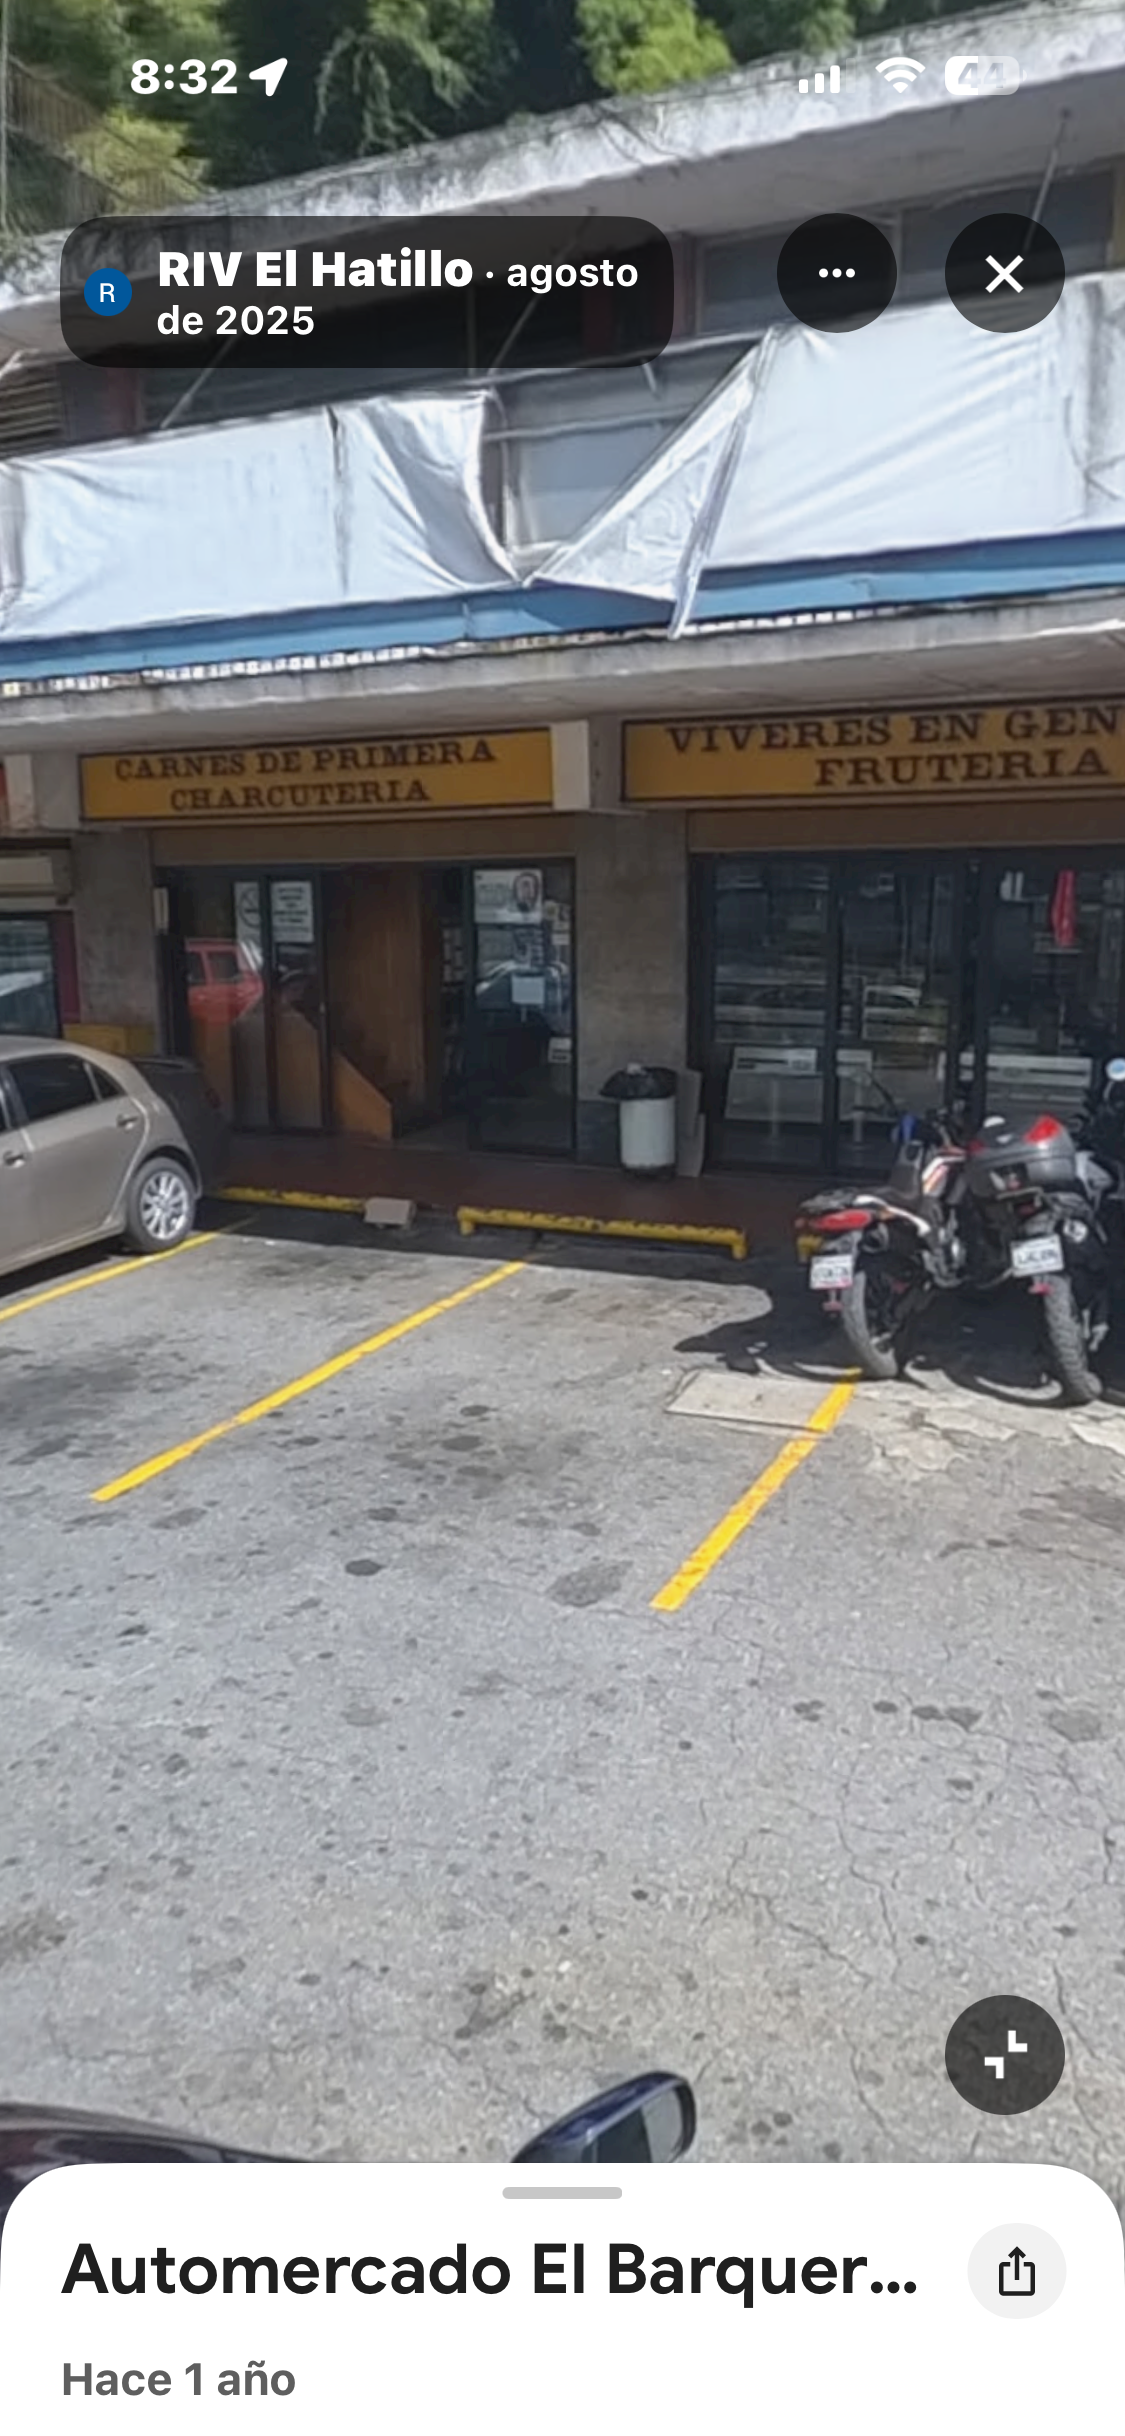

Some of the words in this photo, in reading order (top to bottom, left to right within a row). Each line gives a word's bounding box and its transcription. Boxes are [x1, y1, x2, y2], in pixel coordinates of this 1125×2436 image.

[666, 716, 892, 754] VIVERES
[909, 711, 984, 743] EN
[115, 752, 246, 781] CARNES
[256, 750, 301, 774] DE
[313, 739, 497, 772] PRIMERA
[815, 747, 1110, 787] FRUTERIA
[170, 779, 431, 811] CHARCUTERIA
